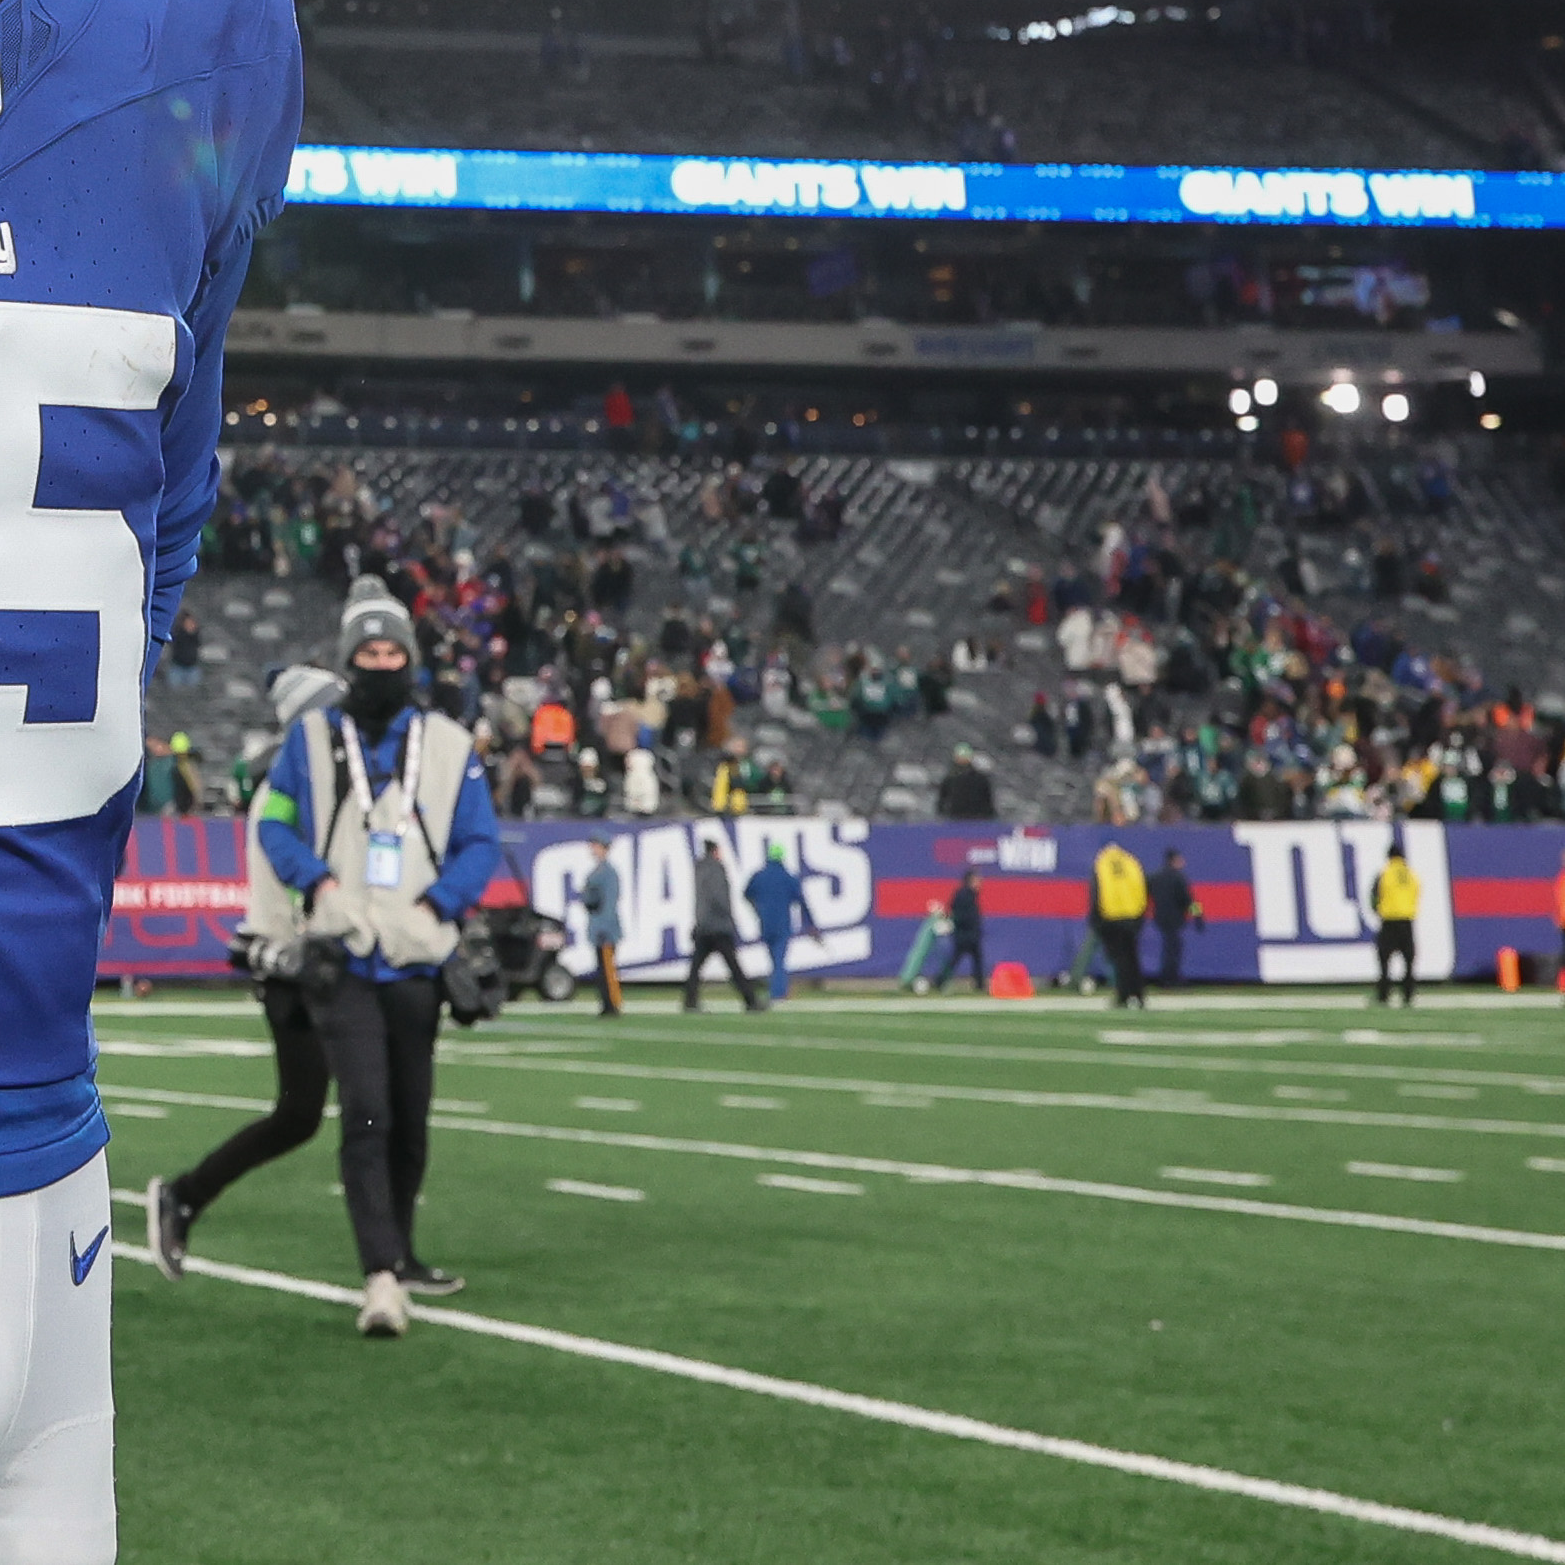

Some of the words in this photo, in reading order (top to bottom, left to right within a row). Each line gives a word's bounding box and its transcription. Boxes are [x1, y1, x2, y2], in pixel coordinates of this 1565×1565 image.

[349, 151, 458, 199] WIN
[671, 159, 859, 209] GIANTS
[861, 164, 966, 211] WIN
[1179, 170, 1369, 217] GIANTS
[1369, 173, 1475, 218] WIN
[531, 813, 871, 976] GIANTS
